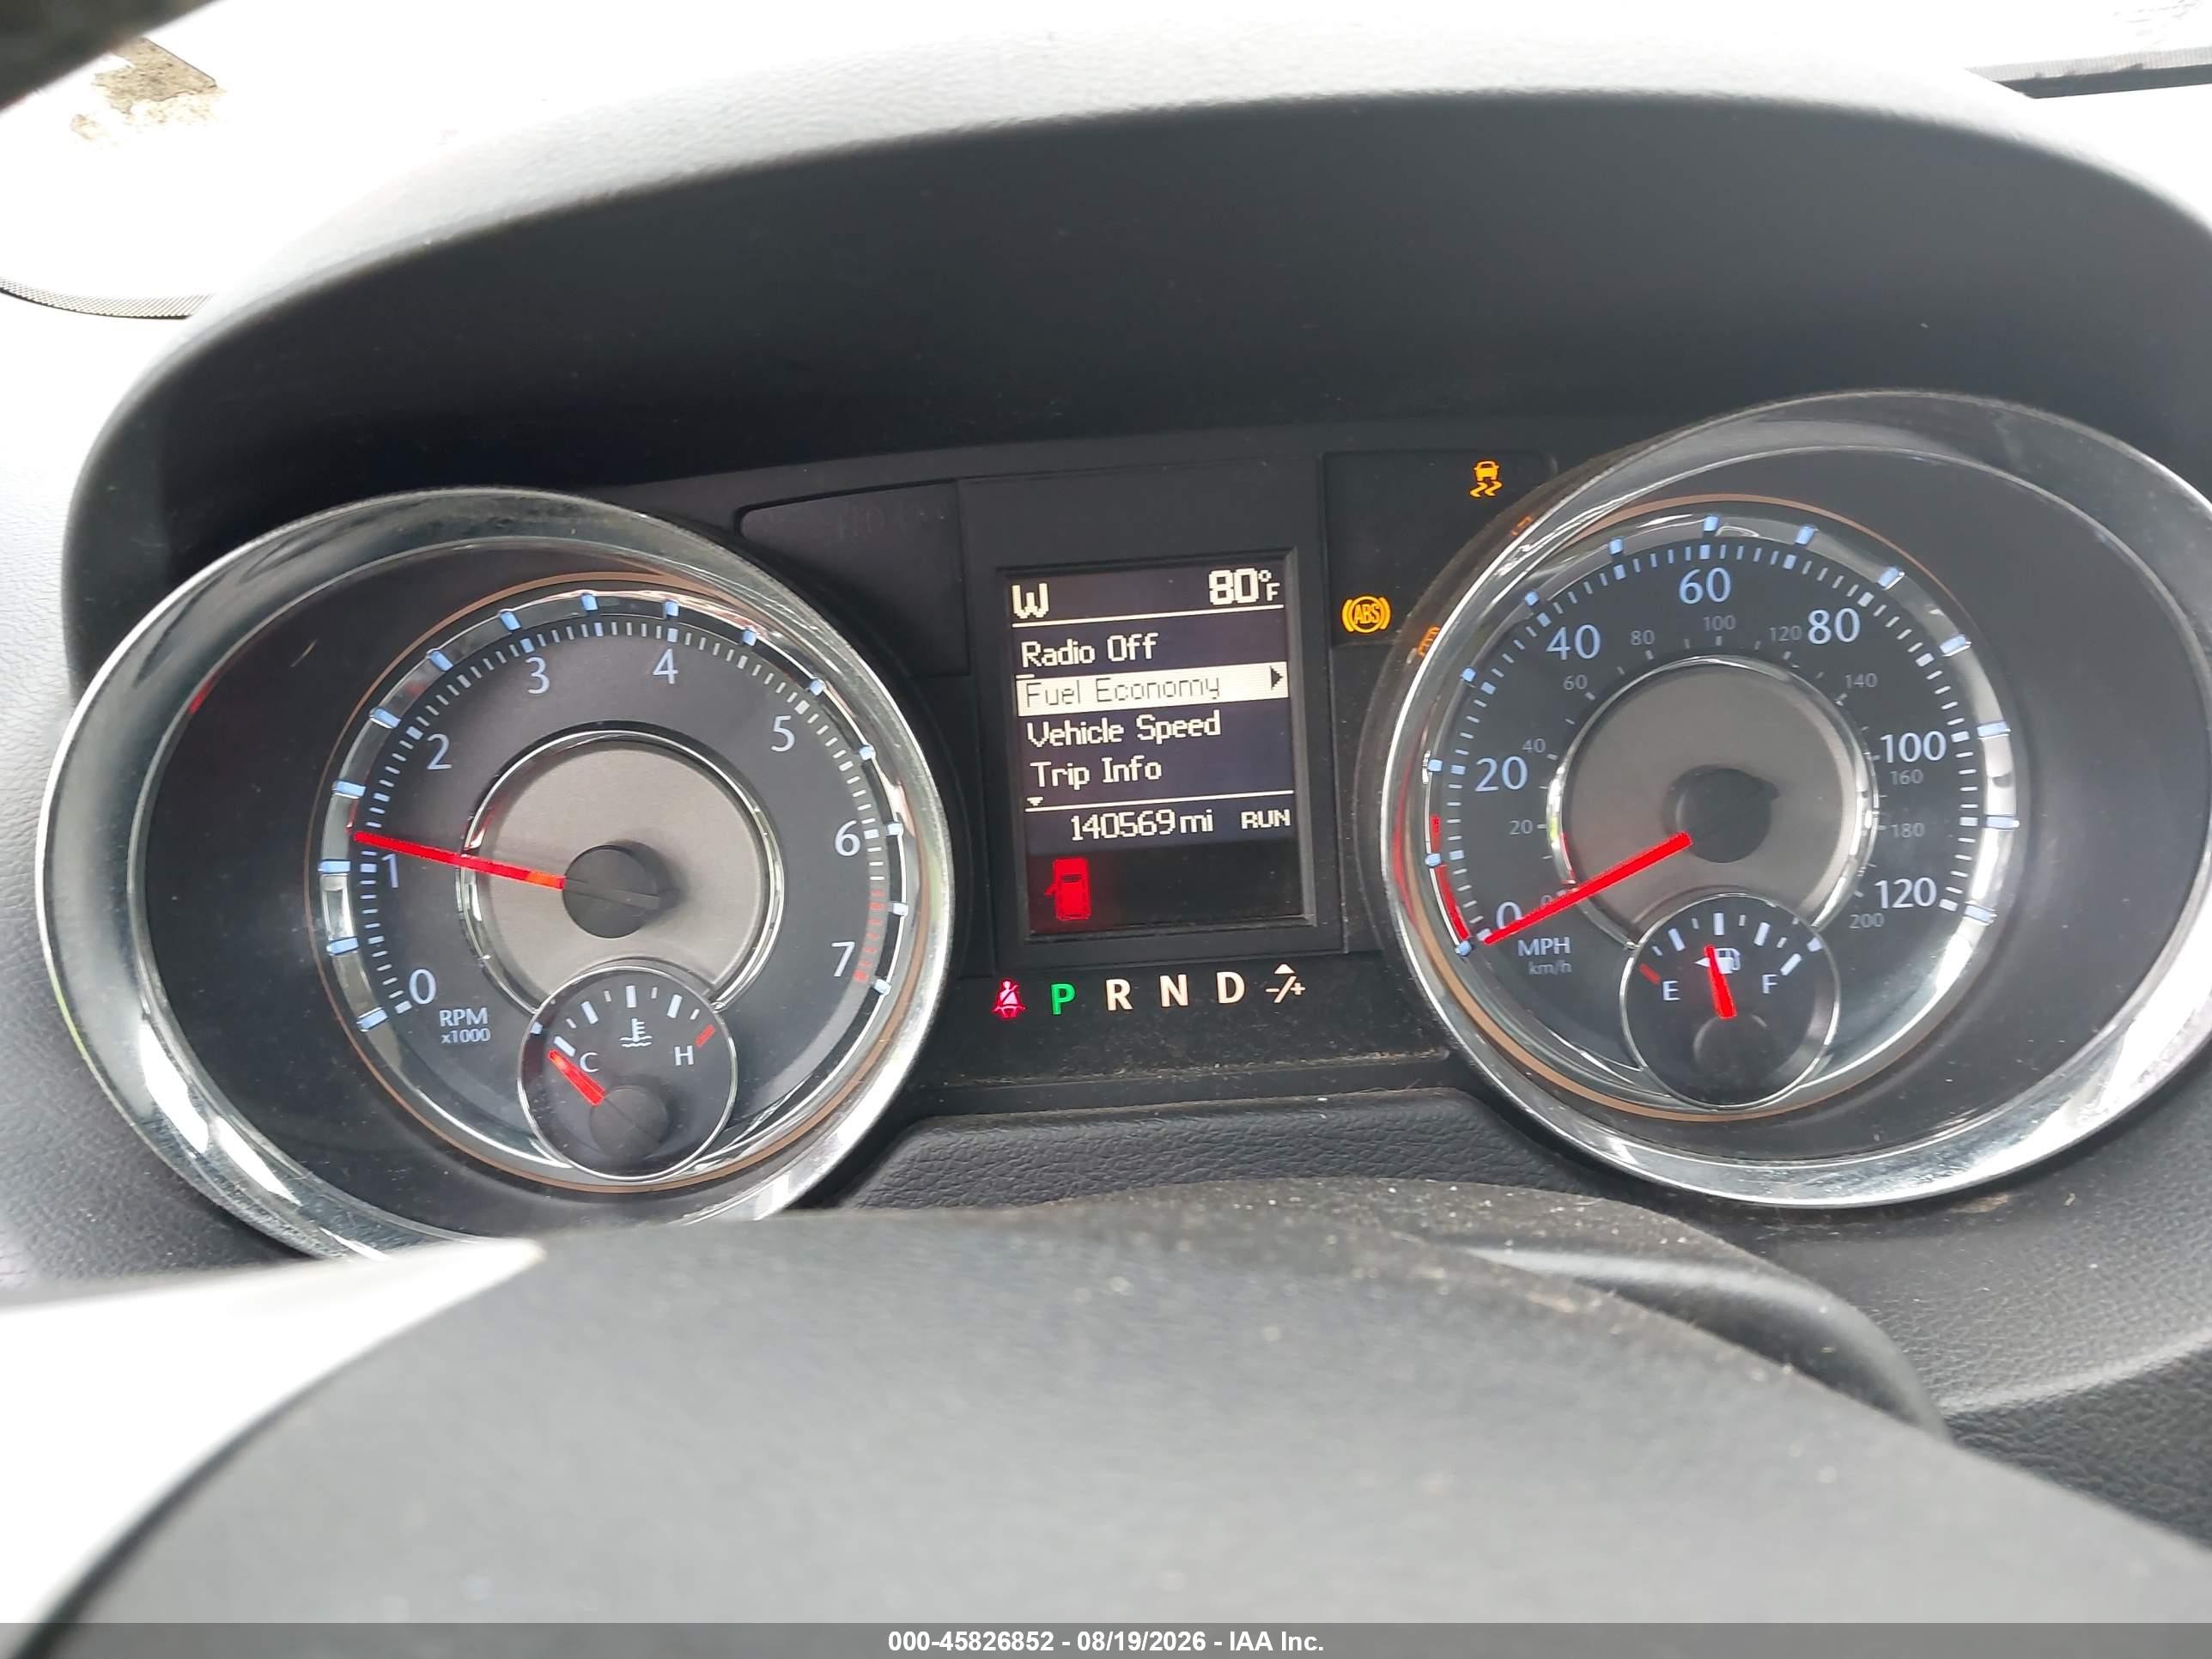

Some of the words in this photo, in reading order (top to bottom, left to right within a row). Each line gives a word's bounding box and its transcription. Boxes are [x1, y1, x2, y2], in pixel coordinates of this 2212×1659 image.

[1012, 583, 1049, 619] W
[1678, 568, 1732, 605] 60
[1353, 603, 1381, 624] ABS
[1704, 615, 1735, 631] 100
[1808, 608, 1860, 643] 80
[1546, 624, 1601, 659] 40
[1631, 629, 1655, 646] 80
[1769, 625, 1802, 642] 120
[1021, 639, 1095, 667] Radio
[1107, 633, 1159, 661] Off
[528, 657, 550, 694] 3
[653, 649, 678, 684] 4
[1845, 672, 1877, 690] 140
[1025, 680, 1081, 708] Fuel
[1095, 677, 1219, 702] Economy
[1563, 673, 1588, 691] 60
[772, 714, 795, 752] 5
[1027, 718, 1125, 747] Vehicle
[1136, 710, 1221, 744] Speed
[427, 734, 452, 771] 2
[1522, 738, 1546, 754] 40
[1881, 731, 1946, 764] 100
[1030, 762, 1090, 790] Trip
[1103, 756, 1162, 783] Info
[1475, 757, 1528, 792] 20
[1890, 769, 1923, 785] 160
[1241, 809, 1291, 830] RUN
[1509, 819, 1533, 836] 20
[1892, 822, 1924, 838] 180
[835, 821, 860, 856] 6
[383, 854, 399, 888] 1
[1875, 878, 1936, 909] 120
[1496, 901, 1522, 930] 0
[1850, 913, 1884, 929] 200
[831, 942, 855, 977] 7
[1517, 936, 1571, 957] MPH
[1528, 960, 1572, 975] km/h
[409, 969, 437, 1006] 0
[1050, 983, 1075, 1015] P
[1105, 978, 1133, 1012] R
[1159, 974, 1188, 1007] N
[1216, 971, 1245, 1004] D
[1663, 981, 1680, 1001] E
[1762, 974, 1778, 994] F
[440, 1008, 489, 1027] RPM
[441, 1028, 491, 1044] x1000
[580, 1052, 599, 1073] C
[674, 1046, 695, 1066] H
